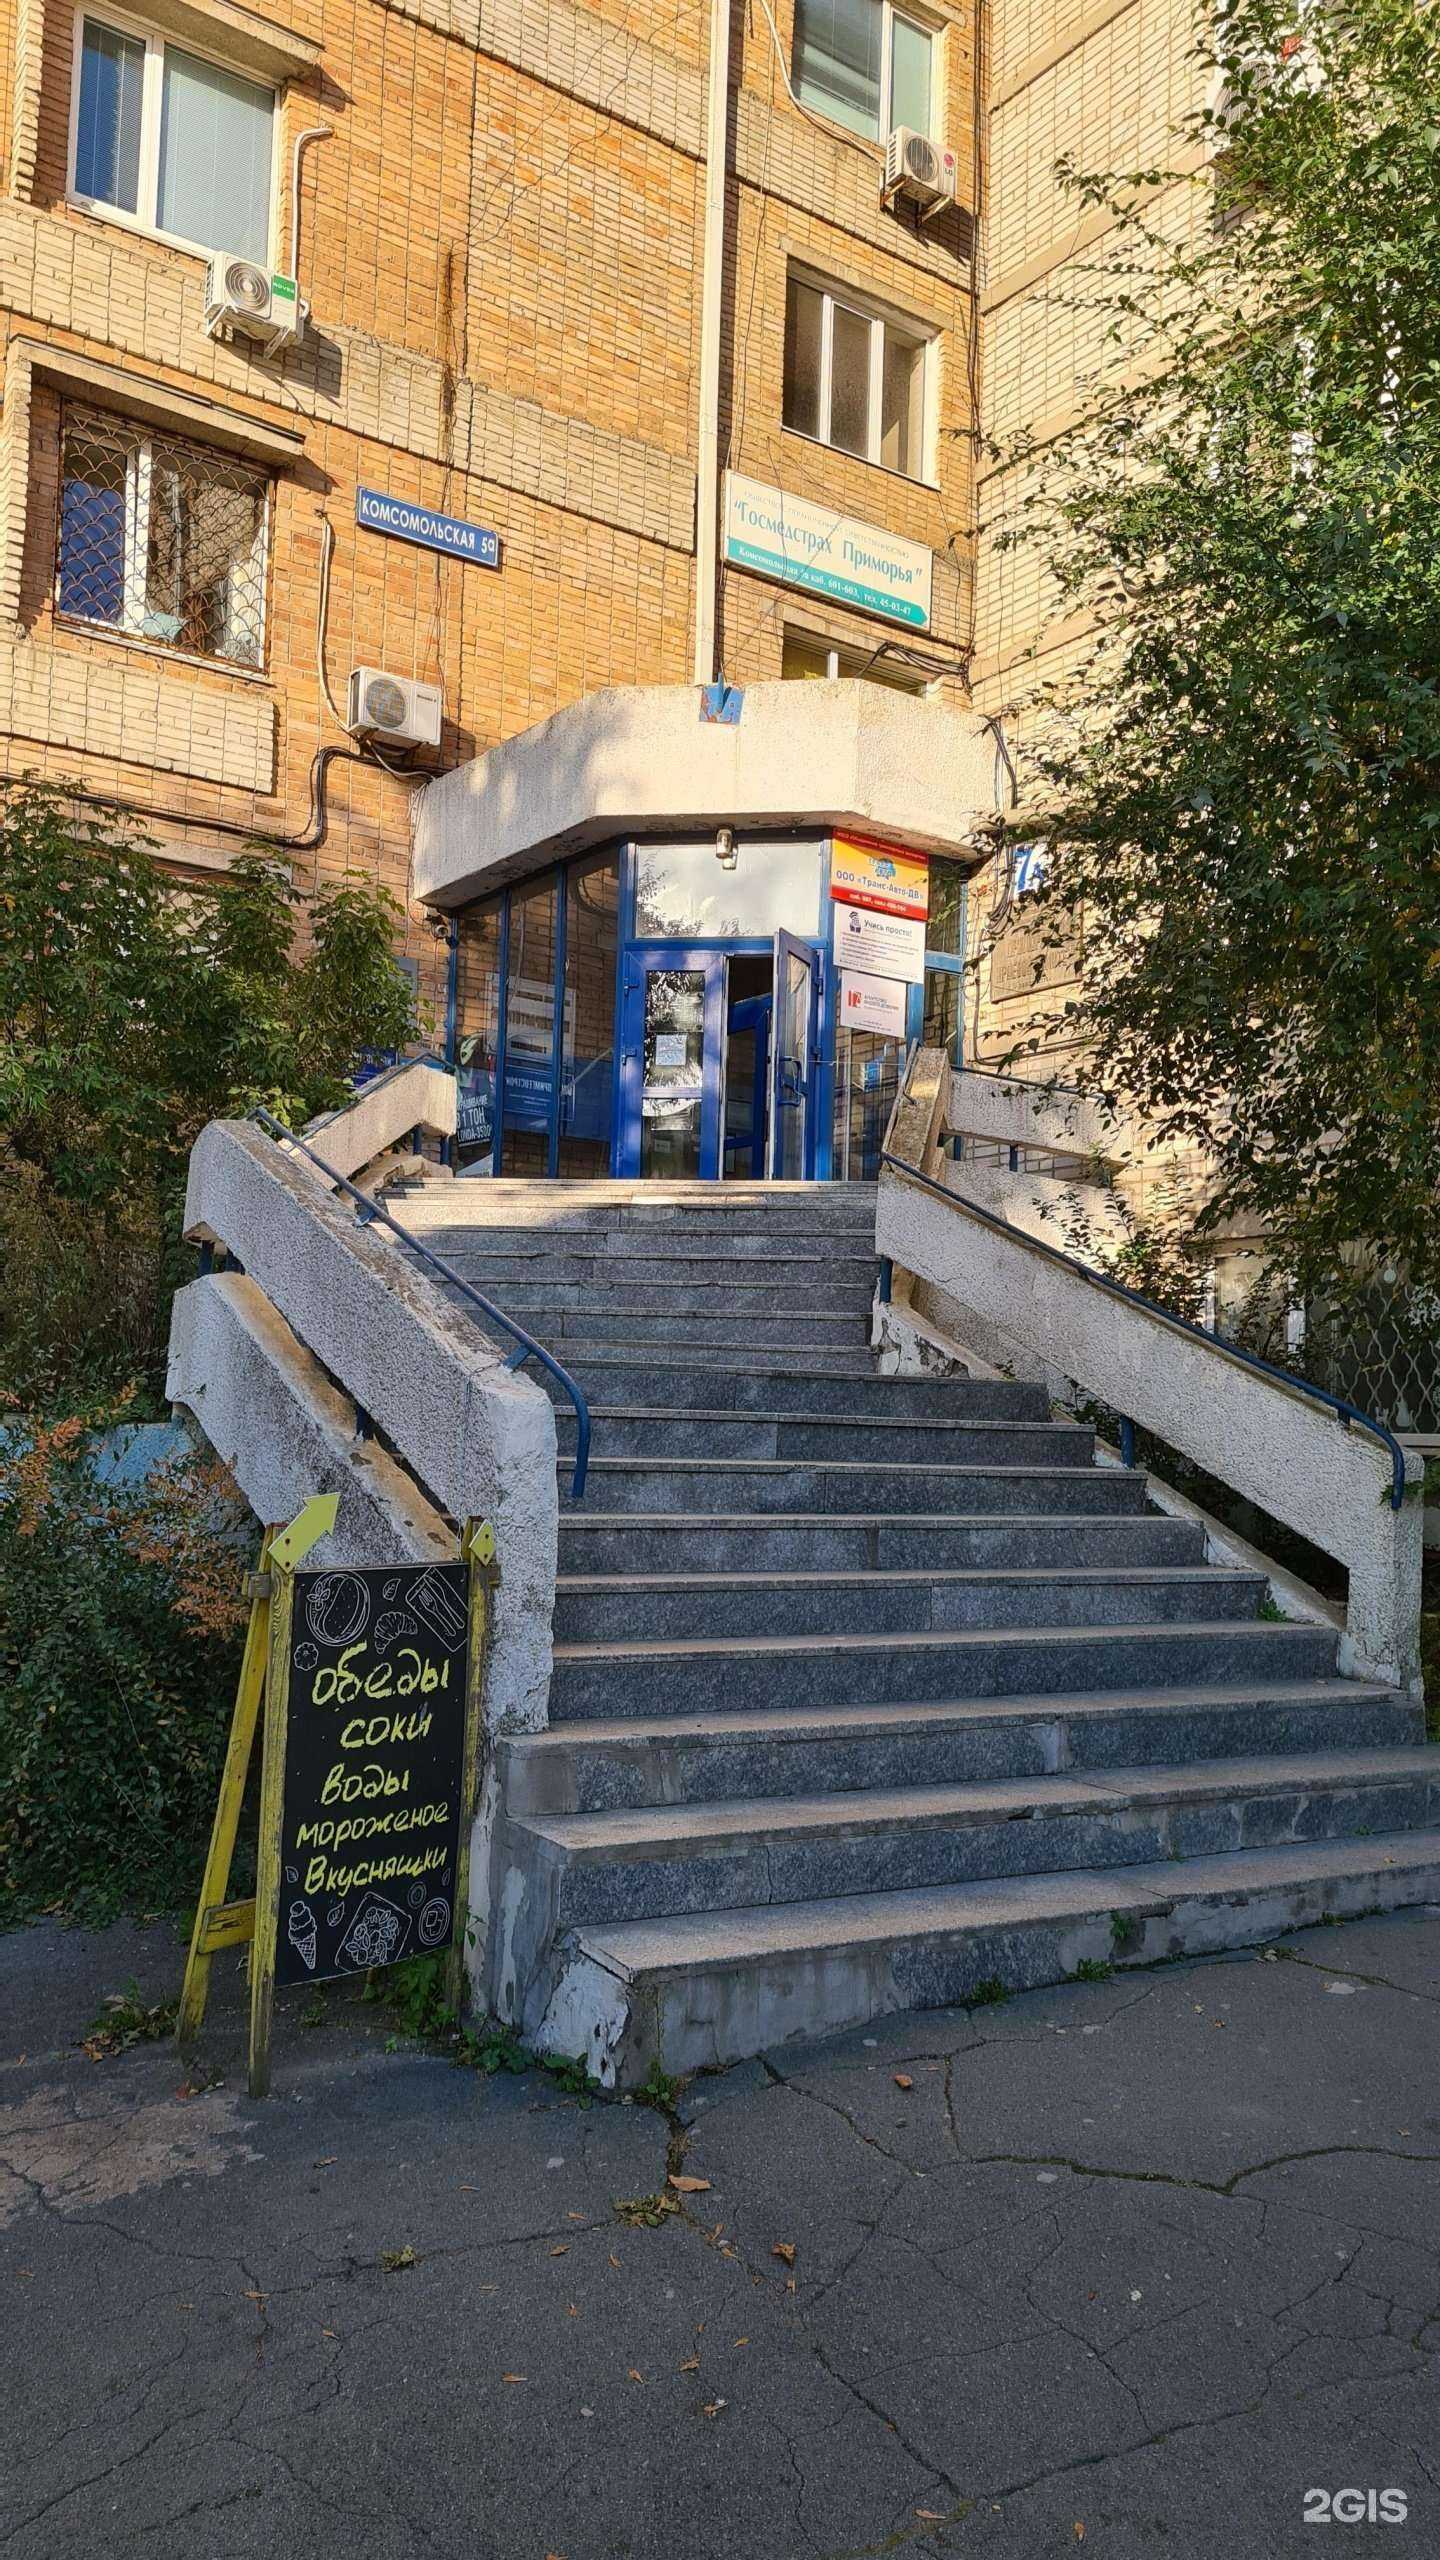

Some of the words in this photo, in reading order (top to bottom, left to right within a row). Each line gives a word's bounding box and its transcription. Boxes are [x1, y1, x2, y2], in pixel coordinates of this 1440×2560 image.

[361, 496, 476, 550] КОМСОМОЛЬСКАЯ
[734, 498, 833, 554] "Госмедстрах
[842, 539, 923, 585] Приморья"
[836, 870, 855, 882] ООО
[864, 919, 885, 931] Учись
[468, 1106, 486, 1126] ТОН
[304, 1845, 448, 1897] Вкусняшки
